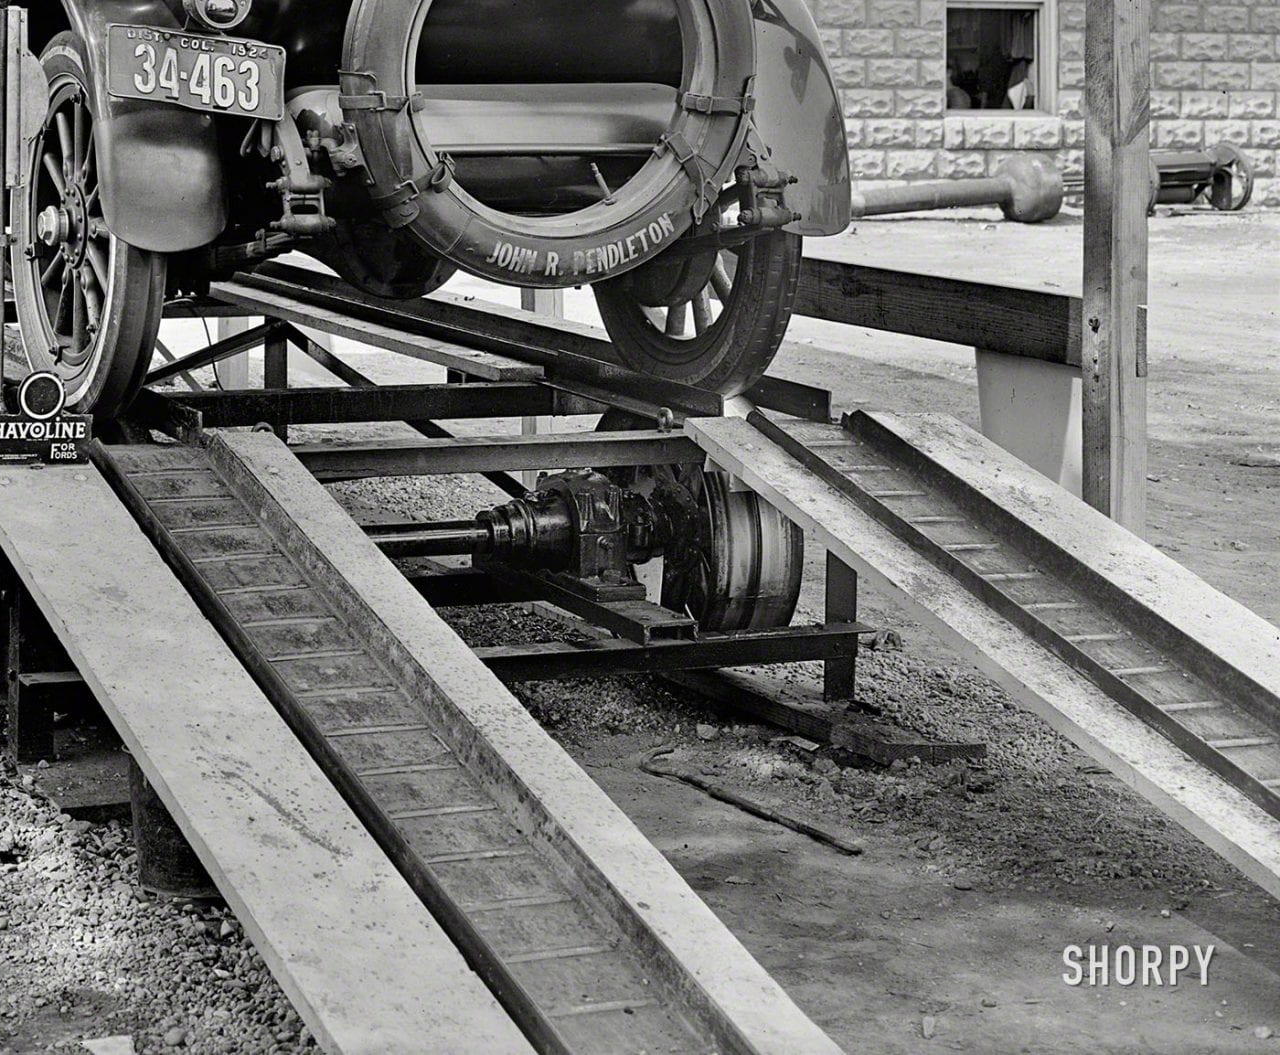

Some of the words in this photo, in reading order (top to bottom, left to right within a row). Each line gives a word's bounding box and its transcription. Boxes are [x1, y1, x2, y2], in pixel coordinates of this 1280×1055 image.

[127, 28, 163, 43] DIST.
[180, 38, 215, 52] COL.
[134, 43, 260, 111] 34-463
[487, 240, 537, 275] JOHN
[544, 250, 564, 277] R.
[573, 212, 675, 275] PENDLETON
